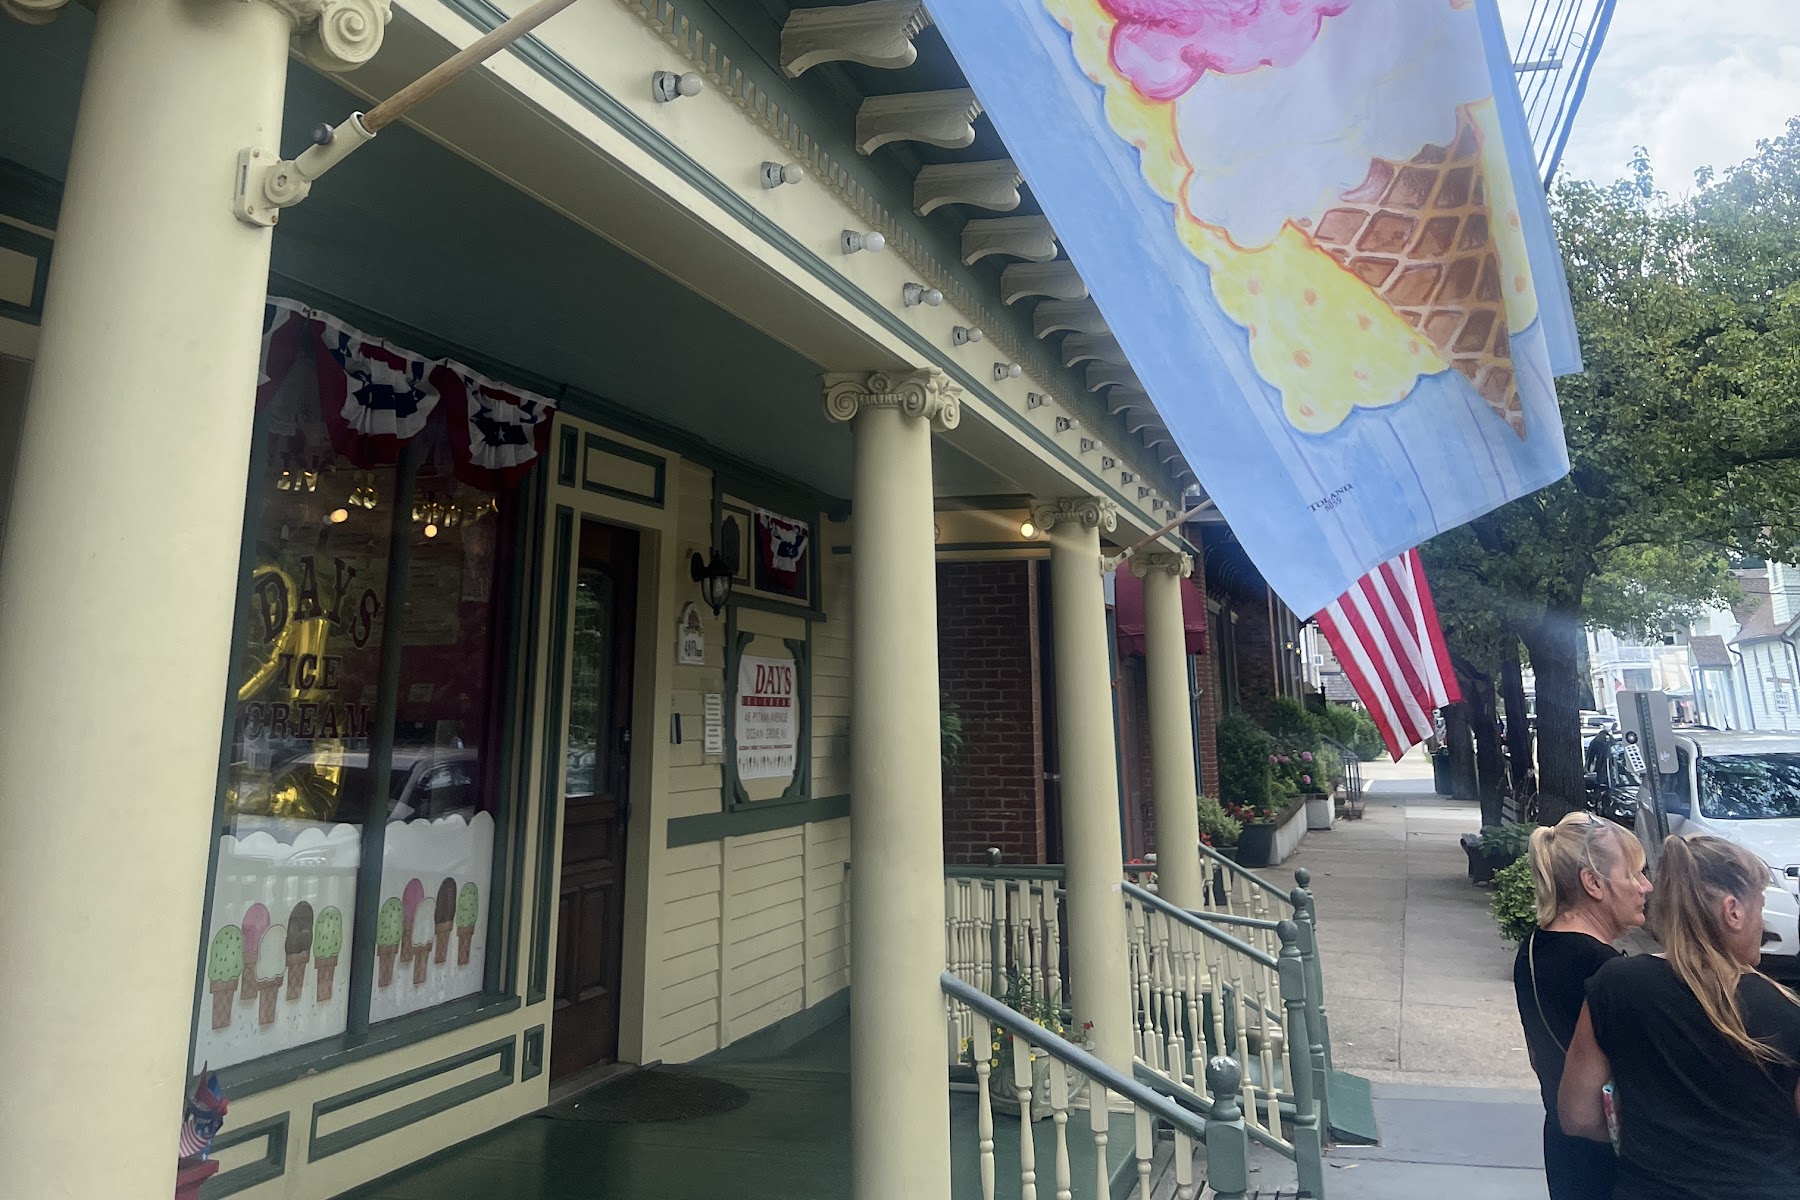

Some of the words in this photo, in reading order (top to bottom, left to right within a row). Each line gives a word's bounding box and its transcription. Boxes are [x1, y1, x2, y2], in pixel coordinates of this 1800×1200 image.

[1307, 483, 1353, 511] TOLAND
[277, 652, 342, 691] ICE
[755, 664, 791, 694] DAY'S
[243, 702, 369, 741] CREAM
